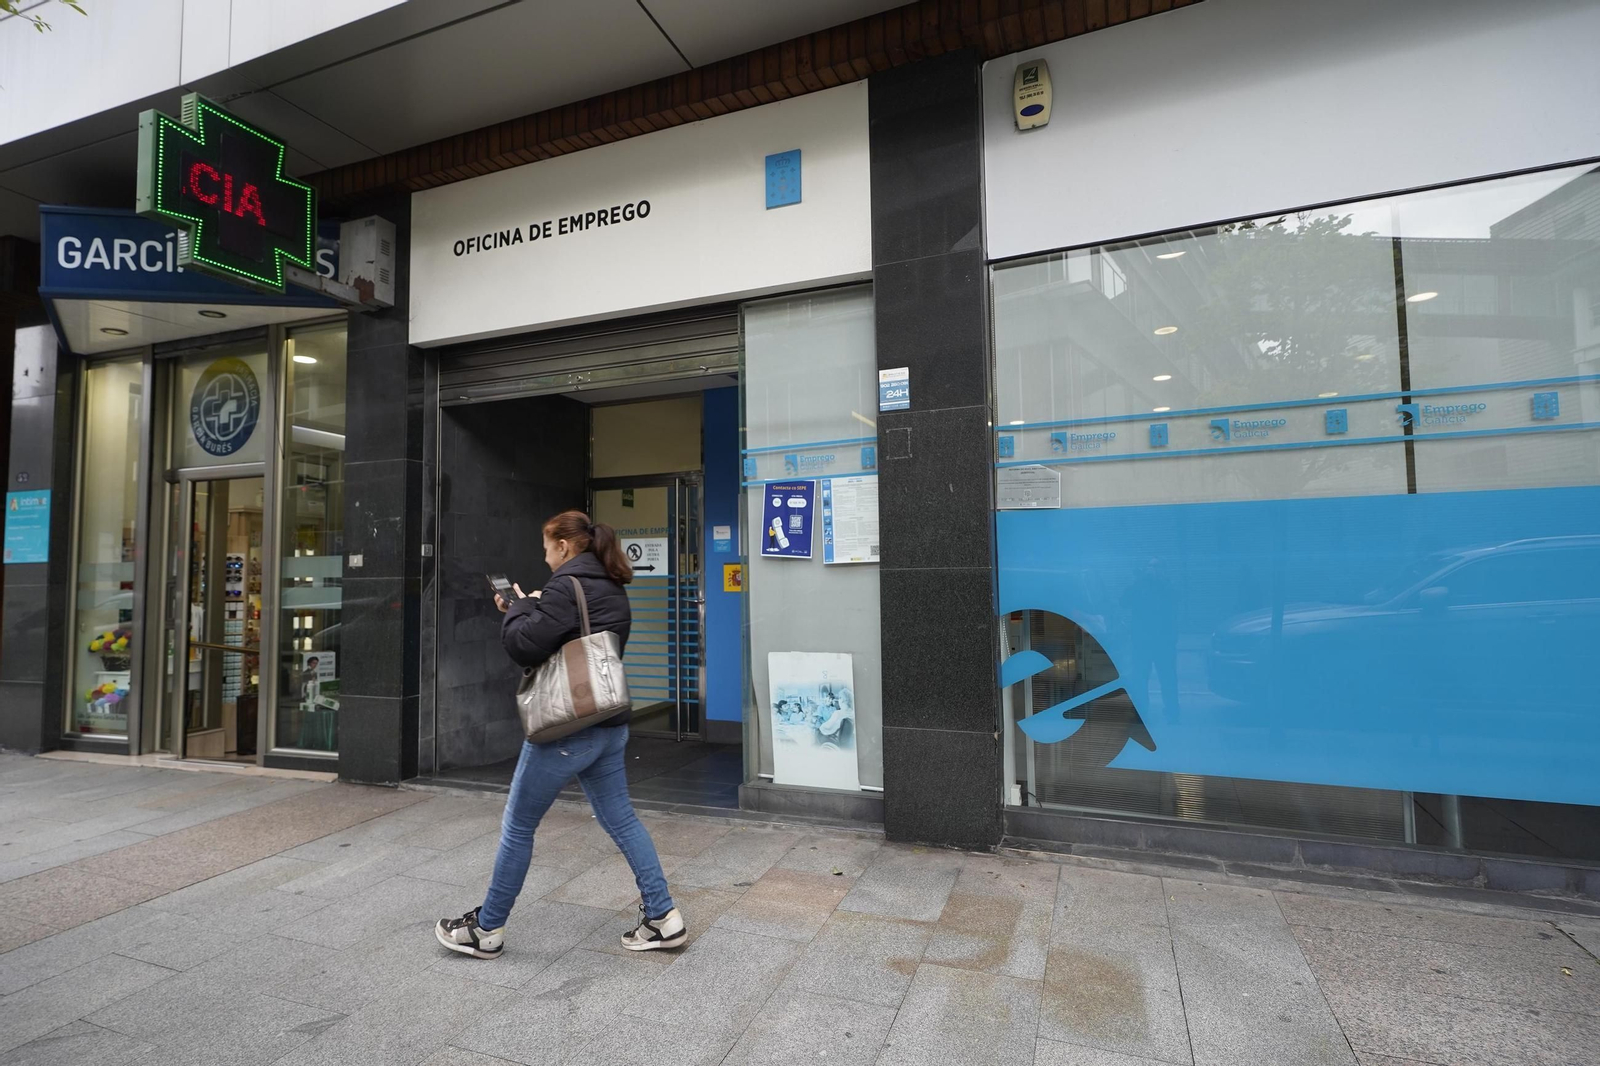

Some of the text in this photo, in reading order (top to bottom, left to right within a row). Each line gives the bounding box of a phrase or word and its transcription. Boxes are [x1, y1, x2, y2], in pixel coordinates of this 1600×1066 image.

[453, 199, 652, 257] OFICINA DE EMPREGO
[57, 233, 184, 275] GARCÍ
[886, 388, 908, 399] 24H
[1424, 401, 1487, 415] Emprego
[1233, 417, 1287, 429] Emprego
[1424, 414, 1467, 425] Galicia
[1070, 431, 1116, 442] Emprego
[1233, 429, 1270, 439] Galicia
[1070, 441, 1101, 450] Galicia
[799, 453, 836, 464] Emprego
[614, 528, 638, 537] FICINA
[639, 527, 649, 535] DE
